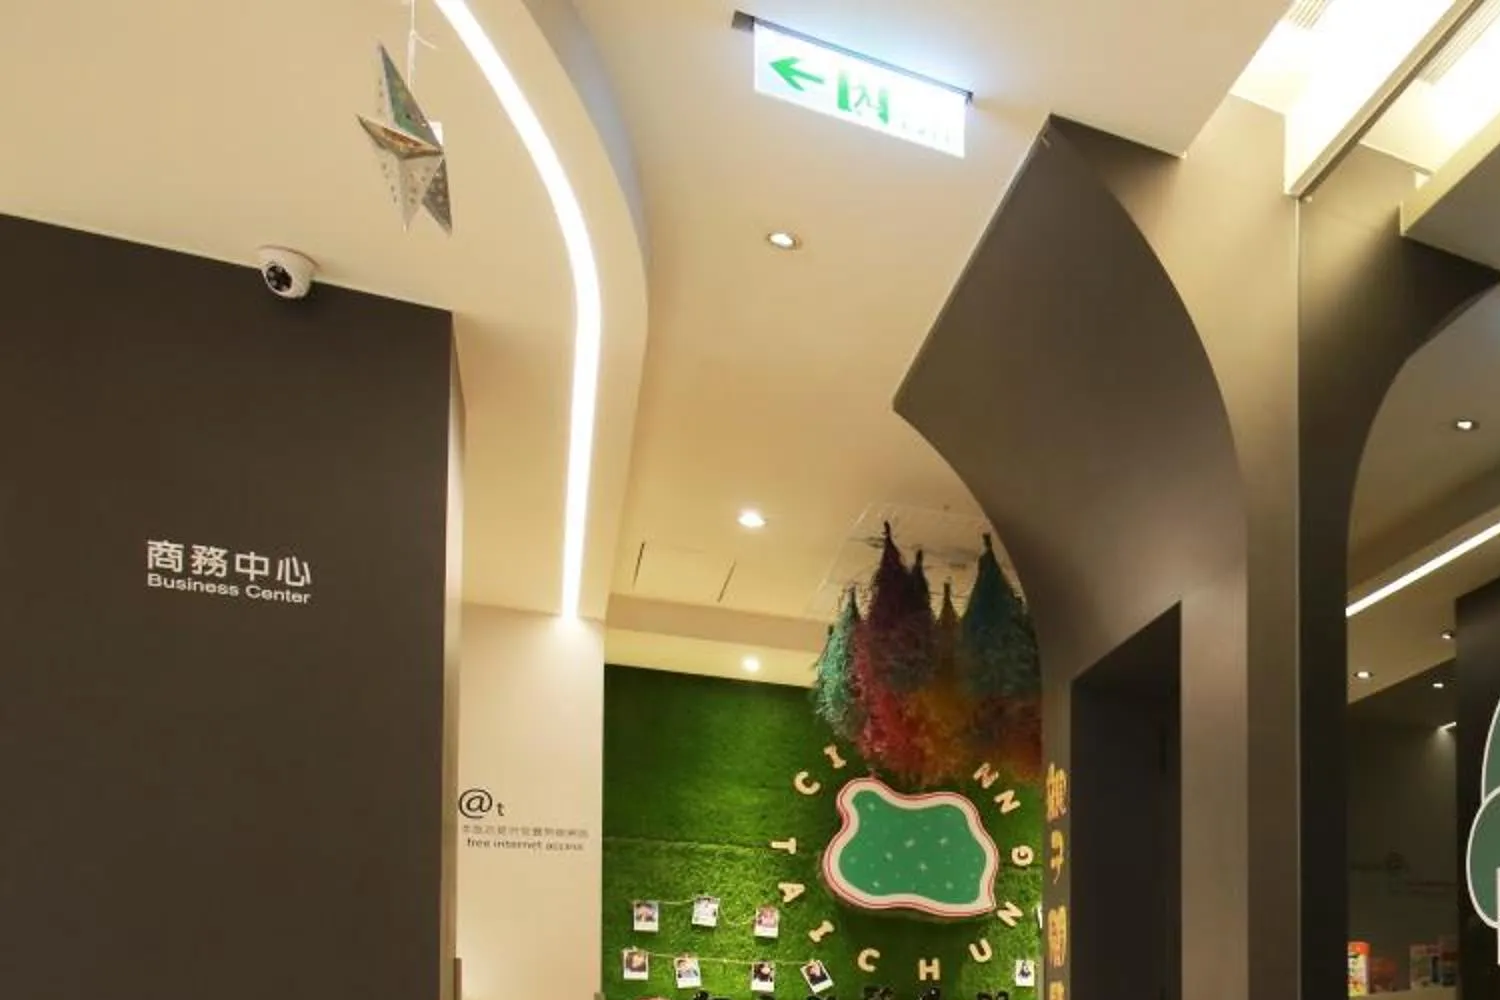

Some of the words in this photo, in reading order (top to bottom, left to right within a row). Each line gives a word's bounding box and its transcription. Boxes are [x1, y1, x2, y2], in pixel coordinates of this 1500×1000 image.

[147, 540, 311, 587] 商務中心
[147, 573, 240, 597] Business
[245, 584, 312, 604] Center
